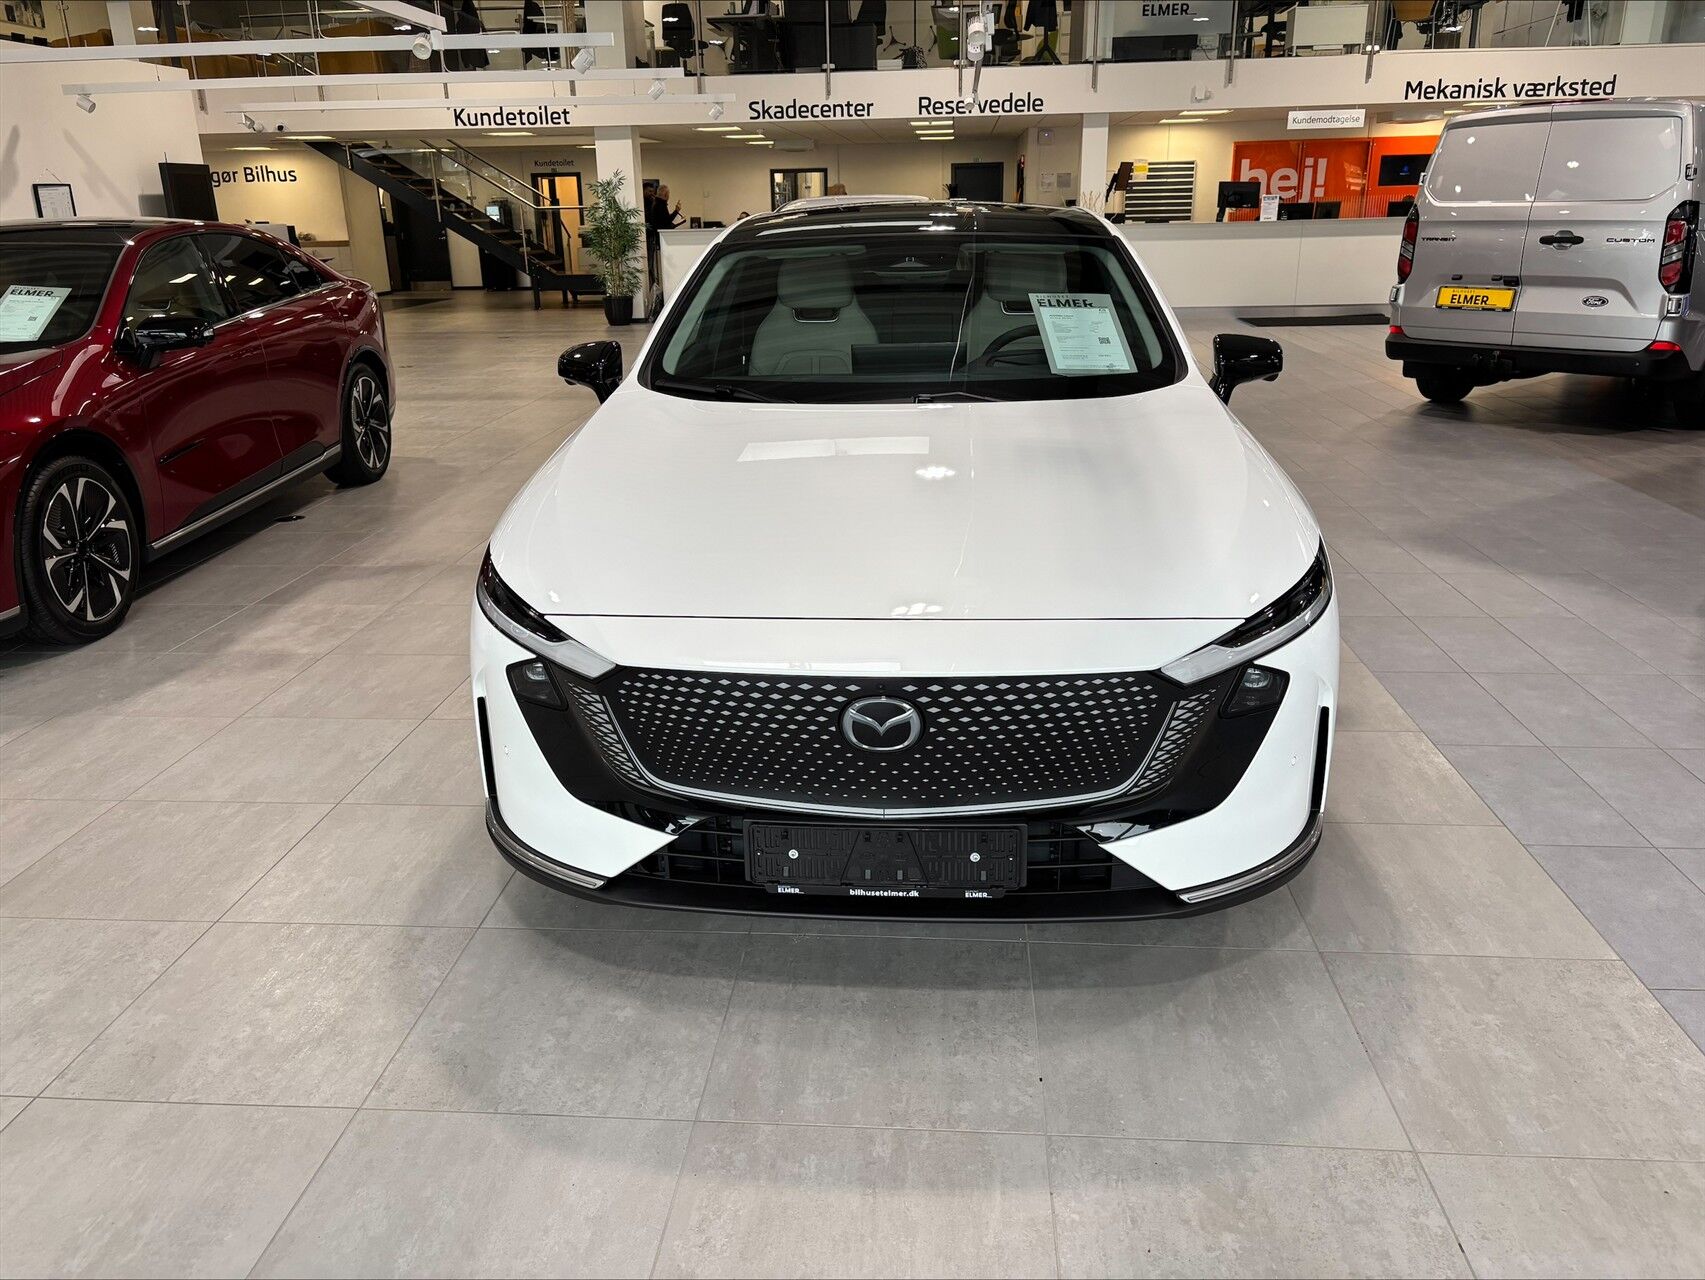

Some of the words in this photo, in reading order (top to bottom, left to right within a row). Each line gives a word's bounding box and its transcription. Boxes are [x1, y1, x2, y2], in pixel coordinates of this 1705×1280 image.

[1142, 3, 1190, 16] ELMER
[1404, 76, 1507, 100] Mekanisk
[1513, 74, 1618, 98] værksted
[453, 105, 570, 126] Kundetoilet
[748, 98, 874, 120] Skadecenter
[1292, 115, 1361, 125] Kundemodtagelse
[534, 159, 575, 167] Kundetoilet
[243, 165, 297, 183] Bilhus
[1450, 293, 1489, 305] ELMER
[849, 888, 920, 897] bilhusetelmer.dk
